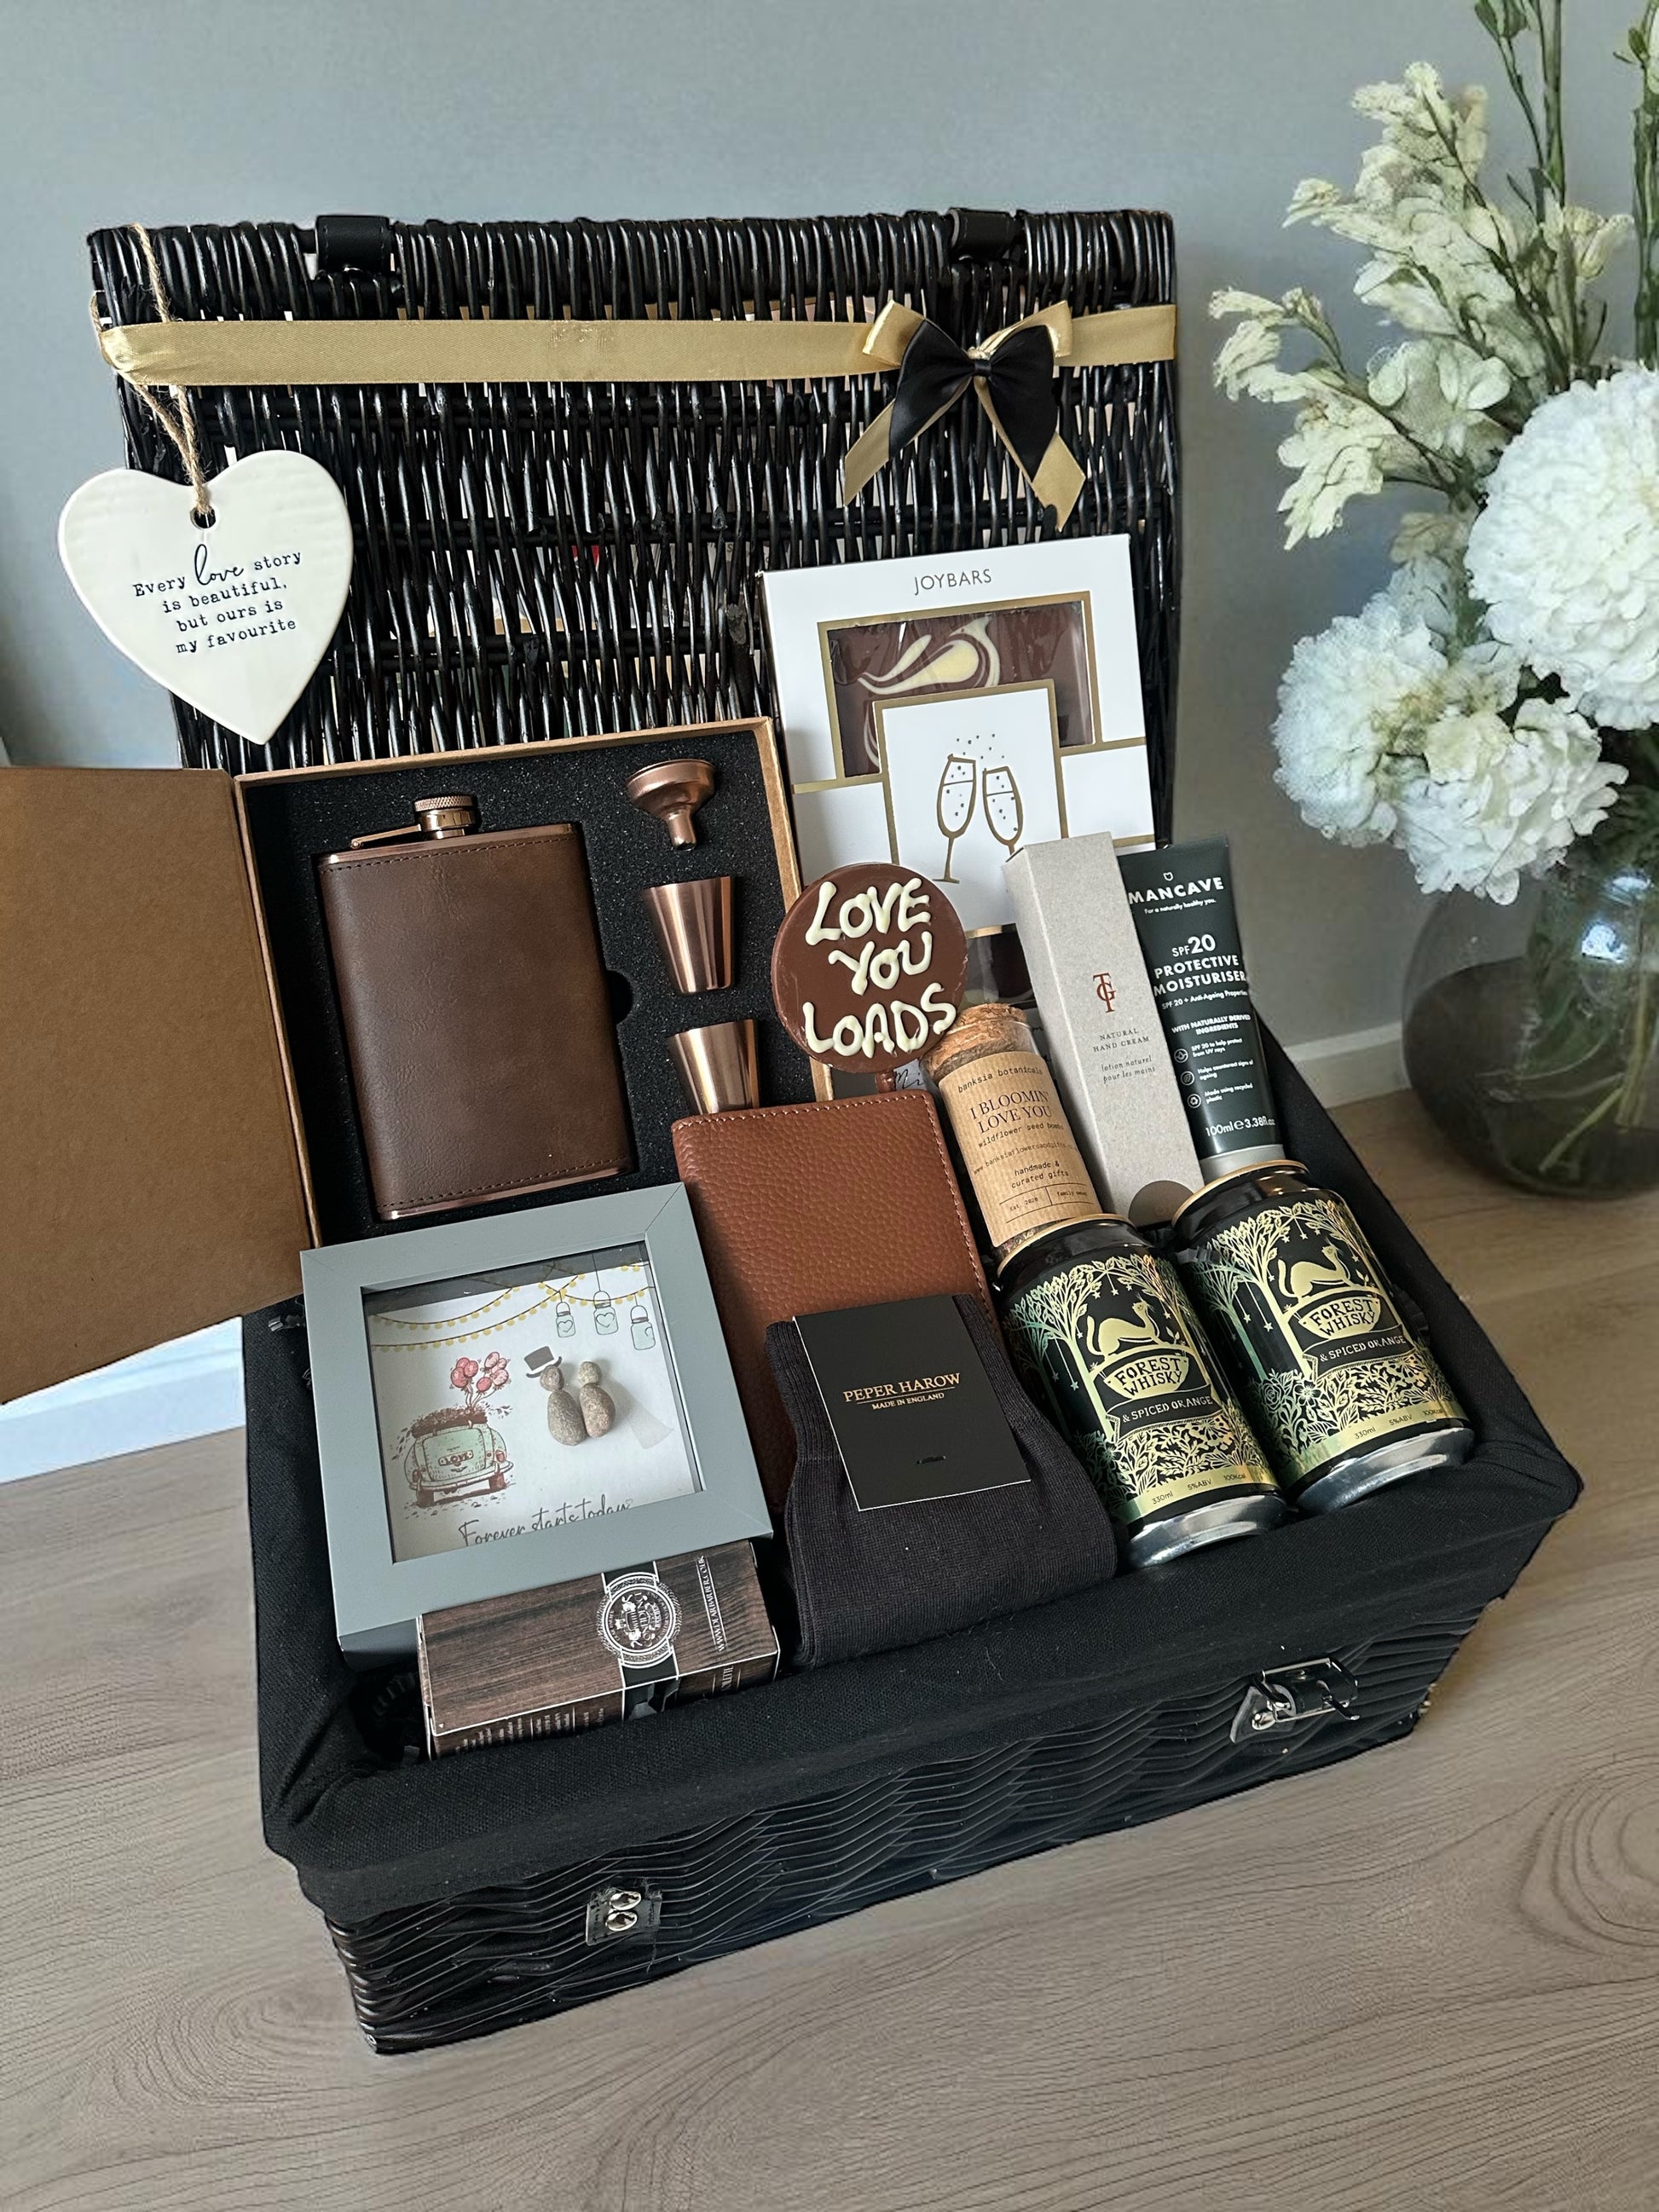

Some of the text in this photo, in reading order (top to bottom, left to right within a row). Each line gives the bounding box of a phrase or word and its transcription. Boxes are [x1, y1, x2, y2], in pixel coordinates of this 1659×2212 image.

[132, 543, 301, 597] Every love story
[914, 569, 991, 595] JOYBARS
[163, 577, 287, 614] is beautiful,
[176, 600, 283, 632] but ours is
[176, 620, 296, 655] my favourite
[1128, 877, 1224, 904] MANCAVE
[806, 877, 931, 946] LOVE
[1159, 903, 1182, 912] naturally
[828, 931, 933, 996] YOU
[1153, 955, 1240, 979] PROTECTIVE
[1153, 970, 1247, 997] MOISTURISER
[1162, 1001, 1173, 1010] SPF
[1190, 991, 1224, 1002] Anti-Ageing
[802, 983, 957, 1059] LOADS
[1171, 1014, 1251, 1033] WITH NATURALLY DERIVED
[1195, 1022, 1239, 1035] INGREDIENTS
[1093, 1036, 1150, 1053] HAND CREAM
[1100, 1028, 1139, 1041] NATURAL
[1101, 1054, 1153, 1072] lotion naturel
[1102, 1074, 1120, 1085] pour
[1134, 1066, 1156, 1077] mains
[957, 1066, 1043, 1093] banksia botanicals
[970, 1107, 977, 1120] I
[978, 1106, 1052, 1134] LOVE YOU
[978, 1126, 1022, 1148] wildflower
[1026, 1123, 1044, 1131] seed
[1011, 1170, 1069, 1188] curated gifts
[1014, 1161, 1051, 1176] handmade
[1309, 1298, 1374, 1326] FOREST
[1320, 1311, 1377, 1337] WHISKY
[1320, 1335, 1407, 1362] & SPICED ORANGE
[1114, 1357, 1182, 1386] FOREST
[1124, 1371, 1183, 1396] WHISKY
[843, 1372, 961, 1403] PEPER HAROW
[871, 1401, 896, 1410] MADE
[907, 1392, 945, 1405] ENGLAND
[1122, 1395, 1213, 1423] & SPICED ORANGE
[1354, 1427, 1376, 1440] 330ml
[1152, 1491, 1174, 1505] 330ml
[458, 1519, 525, 1547] Forever
[532, 1502, 579, 1531] starts
